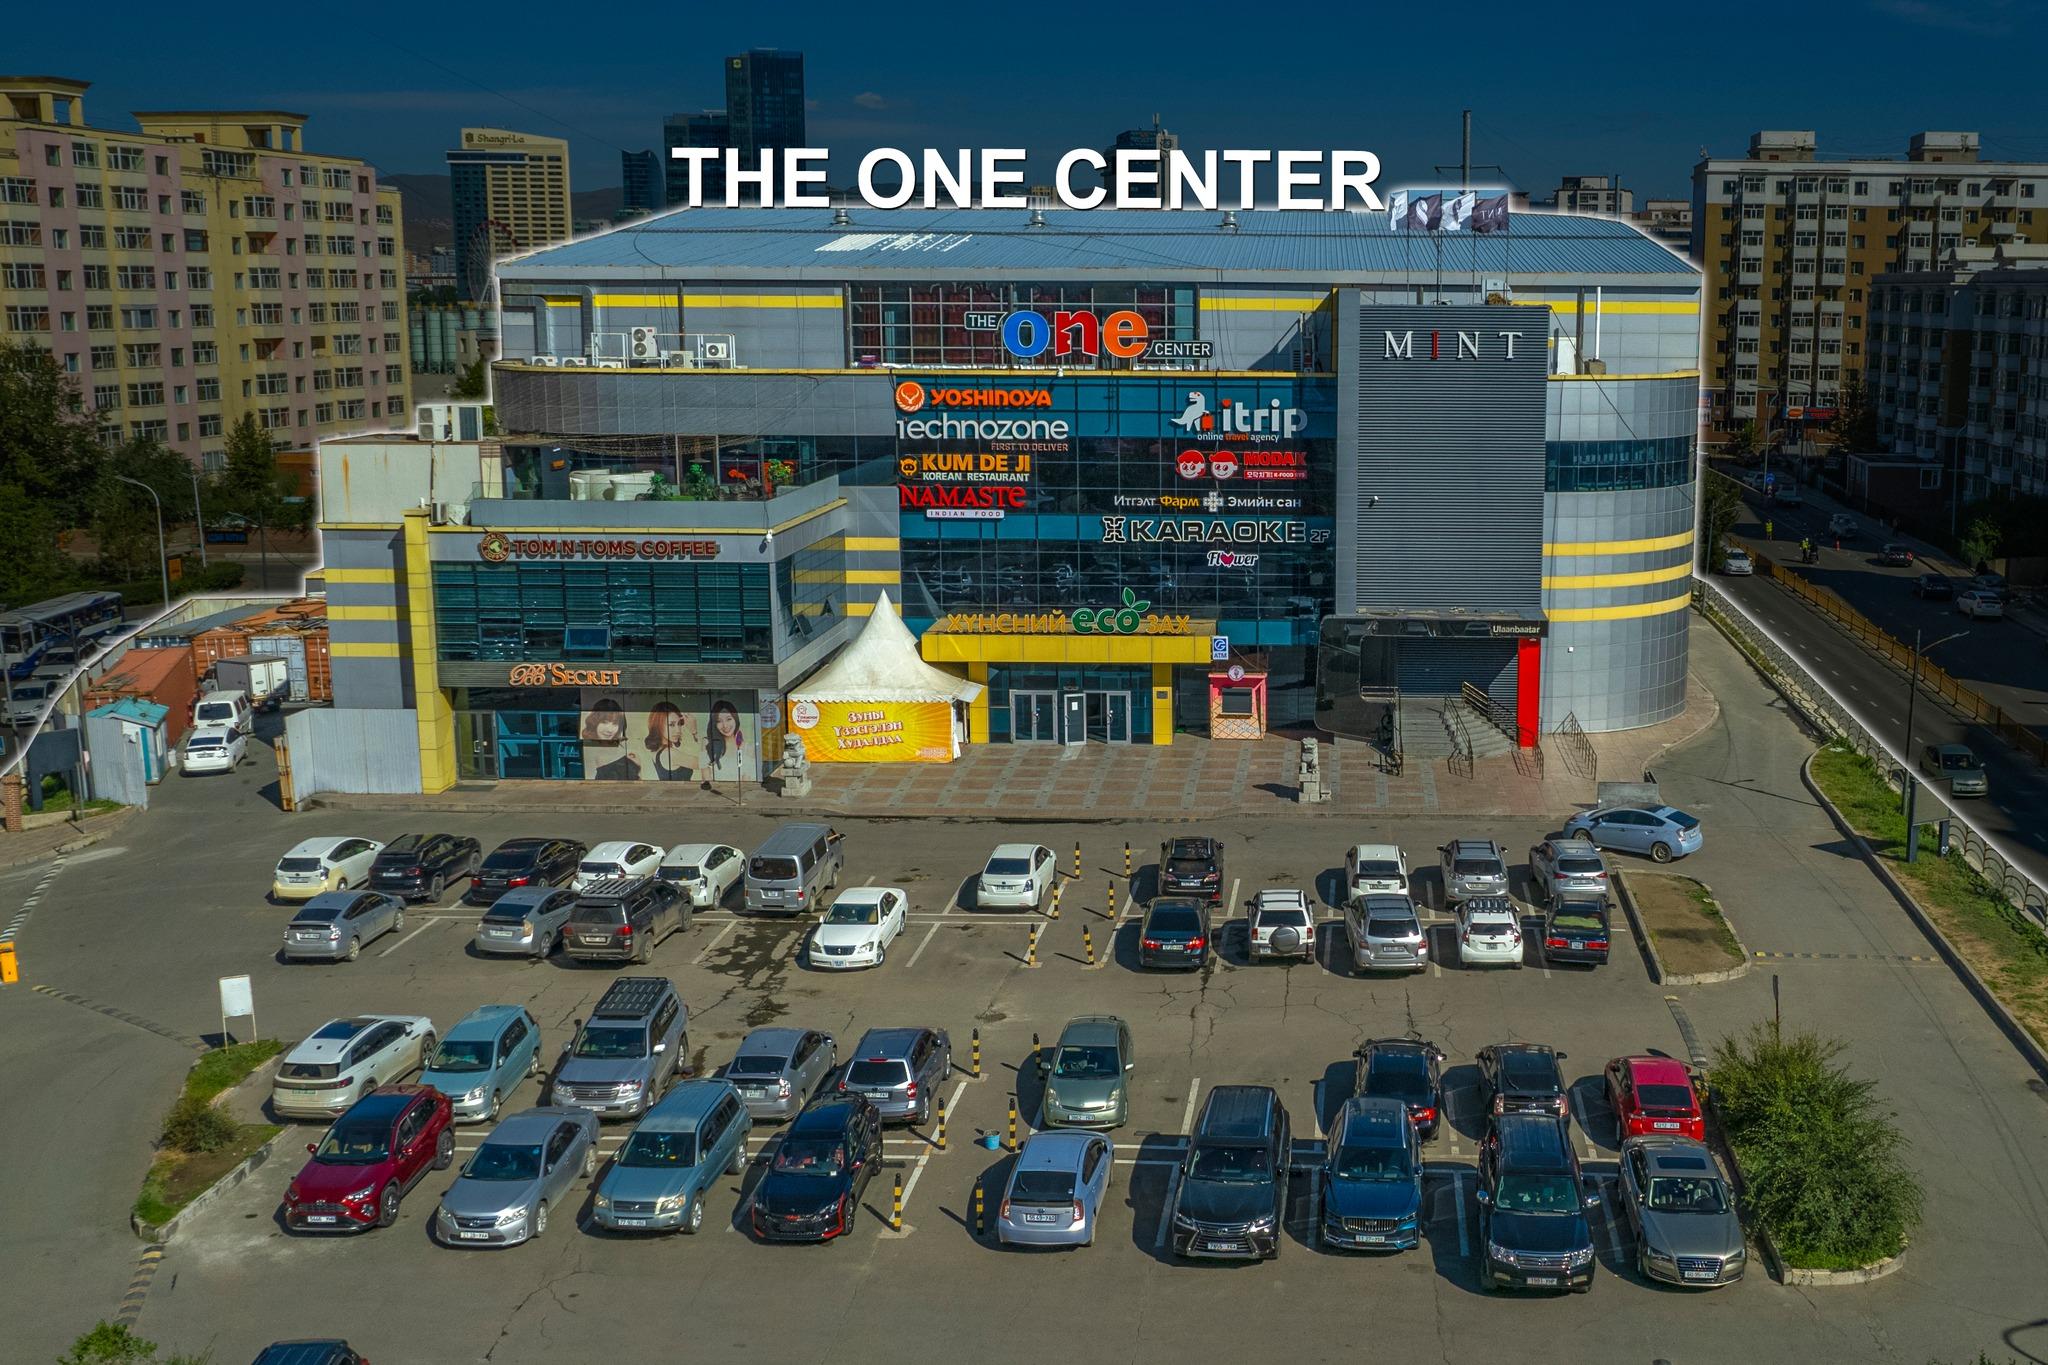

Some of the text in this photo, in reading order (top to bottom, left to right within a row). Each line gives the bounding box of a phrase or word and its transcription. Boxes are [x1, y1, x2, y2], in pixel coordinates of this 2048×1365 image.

[969, 310, 1211, 358] THE one CENTER
[1384, 329, 1523, 360] MINT
[1222, 398, 1308, 438] itrip
[1197, 431, 1280, 443] online travel agency
[991, 443, 1068, 452] FIRST TO DELIVER
[922, 454, 1031, 472] KUM DE JI
[1244, 451, 1307, 466] MODAK
[922, 472, 1030, 482] KOREAN RESTAURANT
[1113, 495, 1301, 509] Итгэлт Фарм Эмийн сан
[1130, 520, 1331, 544] KARAOKE 2F
[513, 540, 557, 556] TOM
[562, 540, 576, 555] N
[580, 540, 637, 556] TOMS
[641, 540, 718, 556] COFFEE
[1071, 607, 1141, 635] eco
[1145, 614, 1191, 634] ЗАХ
[1492, 625, 1540, 634] Ulaanbaatar
